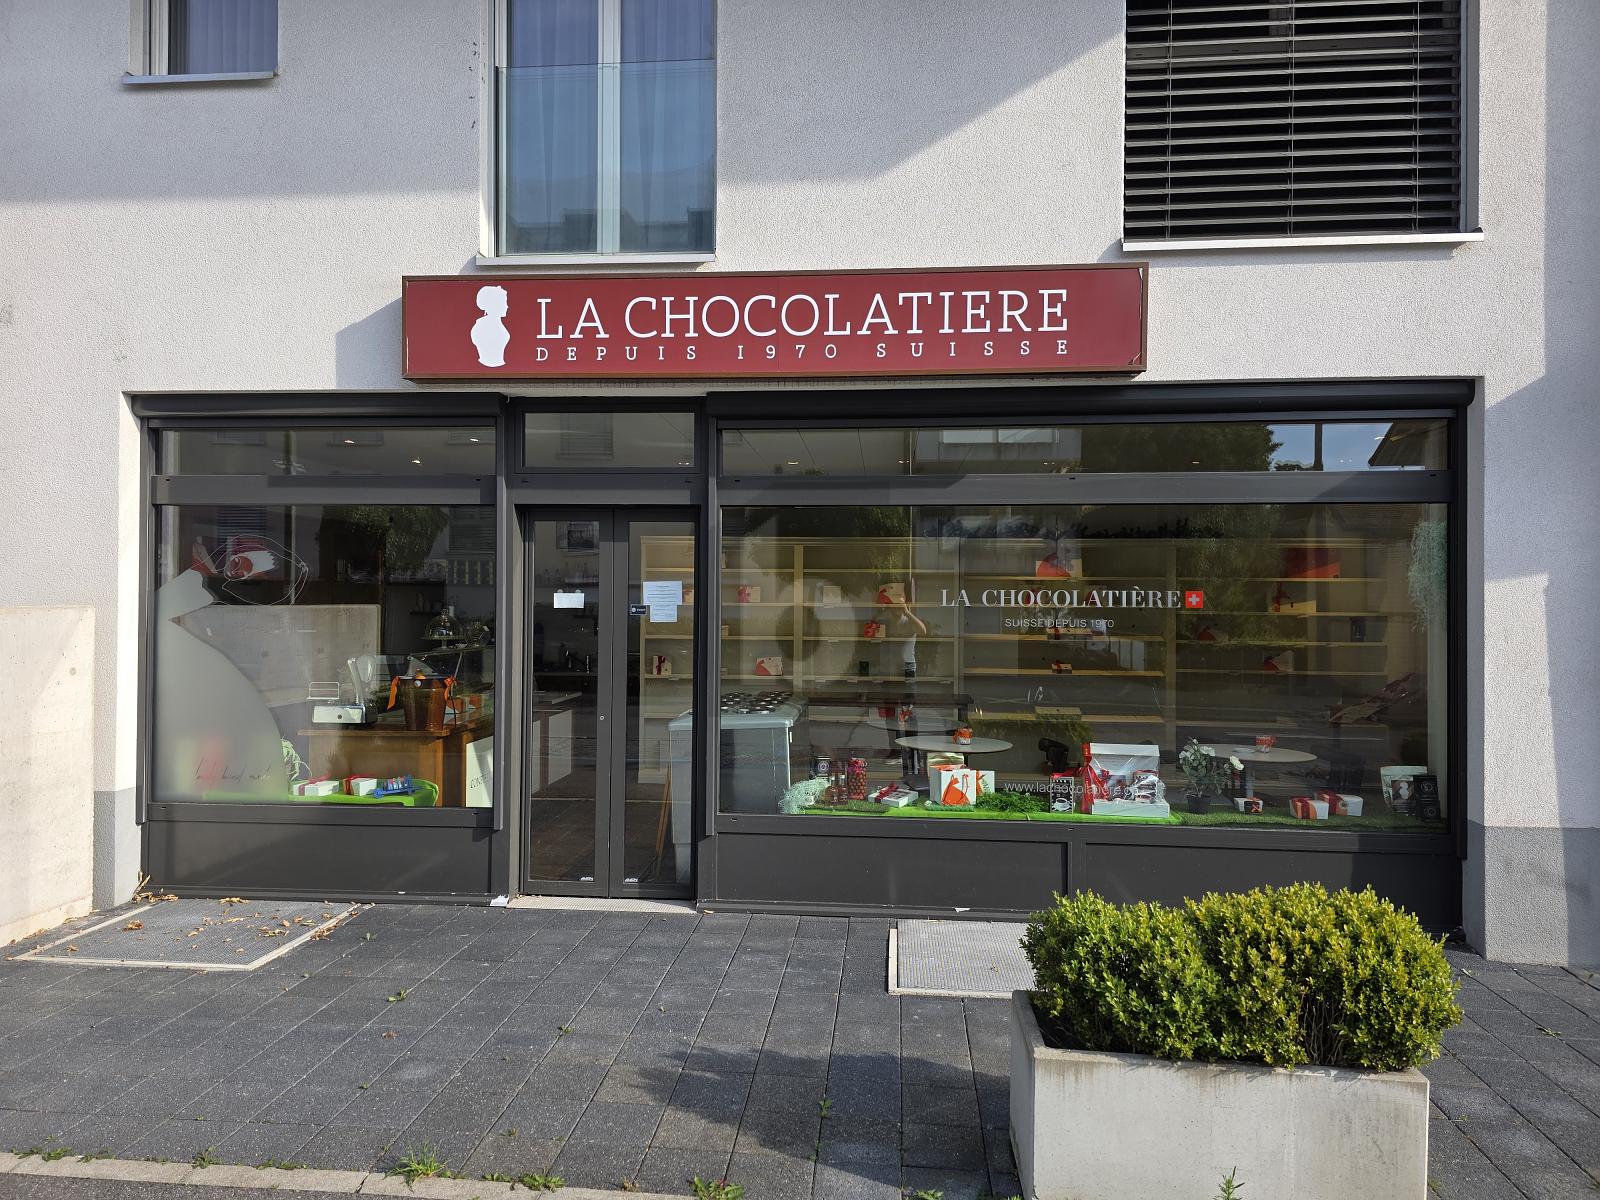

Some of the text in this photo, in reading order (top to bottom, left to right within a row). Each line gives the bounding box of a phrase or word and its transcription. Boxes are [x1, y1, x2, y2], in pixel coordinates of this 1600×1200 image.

[537, 289, 1068, 339] LA CHOCOLATIERE
[536, 340, 1068, 362] DEPUIS 1970 SUISSE
[940, 586, 1181, 608] LA CHOCOLATIÈRE
[1004, 618, 1115, 628] SUISSE DEPUIS 1970
